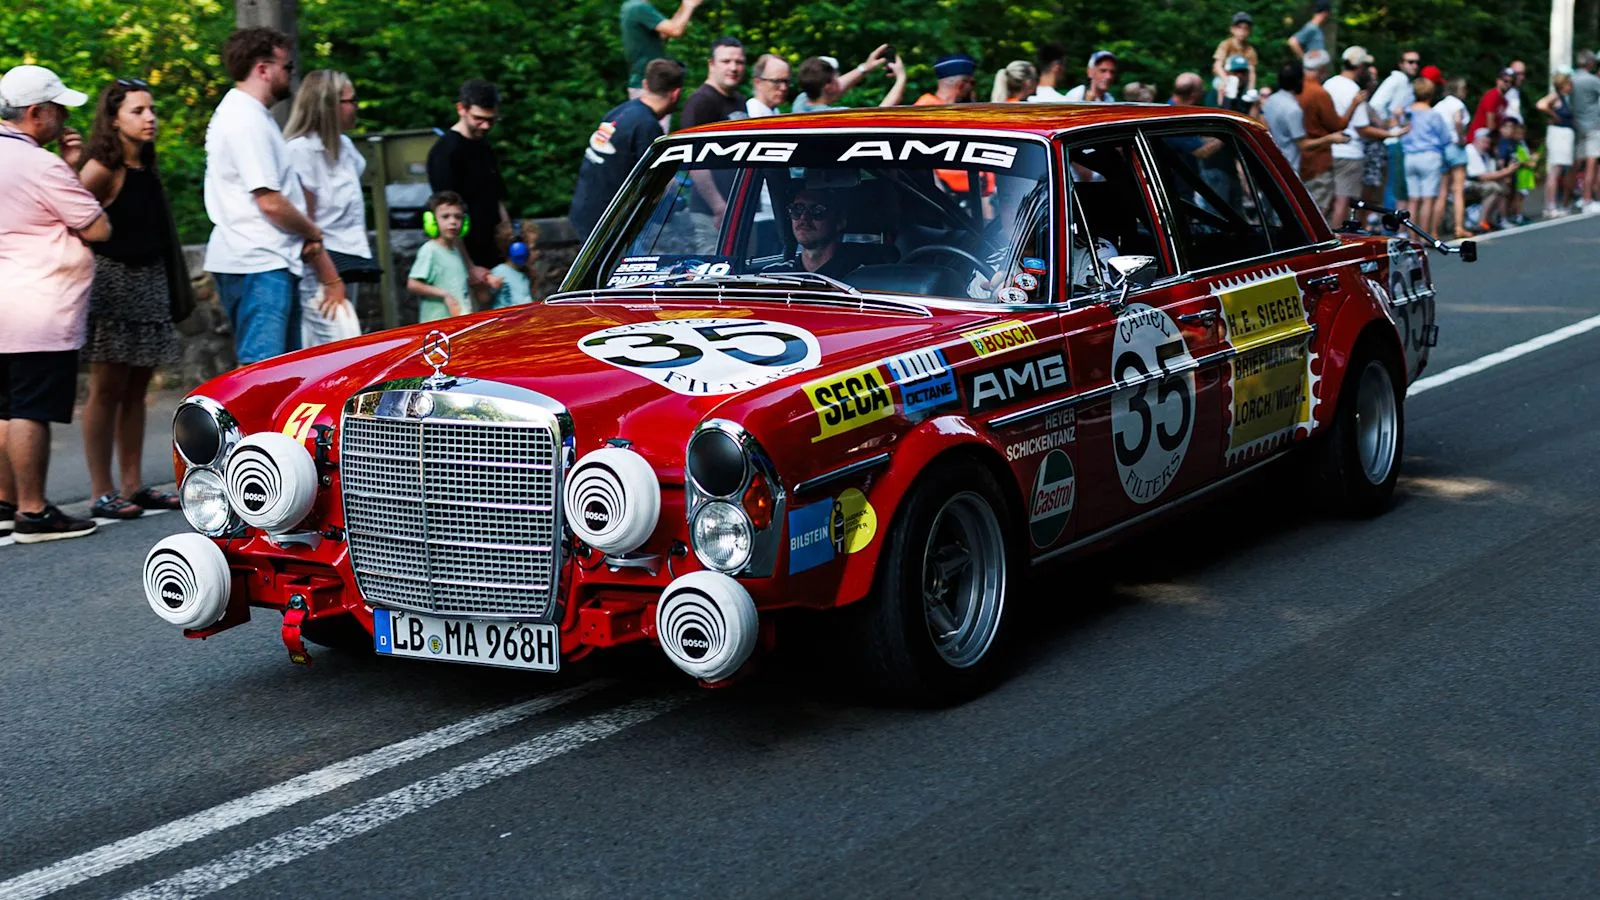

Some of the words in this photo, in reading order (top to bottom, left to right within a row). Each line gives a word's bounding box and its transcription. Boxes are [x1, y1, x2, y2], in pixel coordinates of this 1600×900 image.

[650, 142, 798, 169] AMG
[837, 140, 1017, 168] AMG
[605, 319, 729, 334] CAMEL
[1120, 307, 1170, 344] CAMEL
[1228, 309, 1256, 337] H.E.
[1257, 295, 1302, 328] SIEGER
[583, 321, 809, 369] 35
[981, 324, 1035, 353] BOSCH
[663, 366, 805, 393] FILTERS
[889, 347, 946, 384] 100
[905, 382, 953, 407] OCTANE
[973, 354, 1067, 408] AMG
[814, 373, 890, 426] SECA
[1114, 339, 1191, 466] 35
[1045, 407, 1075, 430] HEYER
[1006, 426, 1076, 462] SCHICKENTANZ
[1126, 453, 1180, 499] FILTERS
[244, 492, 267, 502] BOSCH
[1034, 481, 1073, 516] Castrol
[585, 511, 609, 522] BOSCH
[790, 525, 829, 552] BILSTEIN
[162, 590, 184, 601] BOSCH
[380, 635, 388, 646] D
[392, 614, 425, 652] LB
[445, 620, 479, 657] MA
[486, 624, 553, 665] 968H
[682, 638, 709, 648] BOSCH
